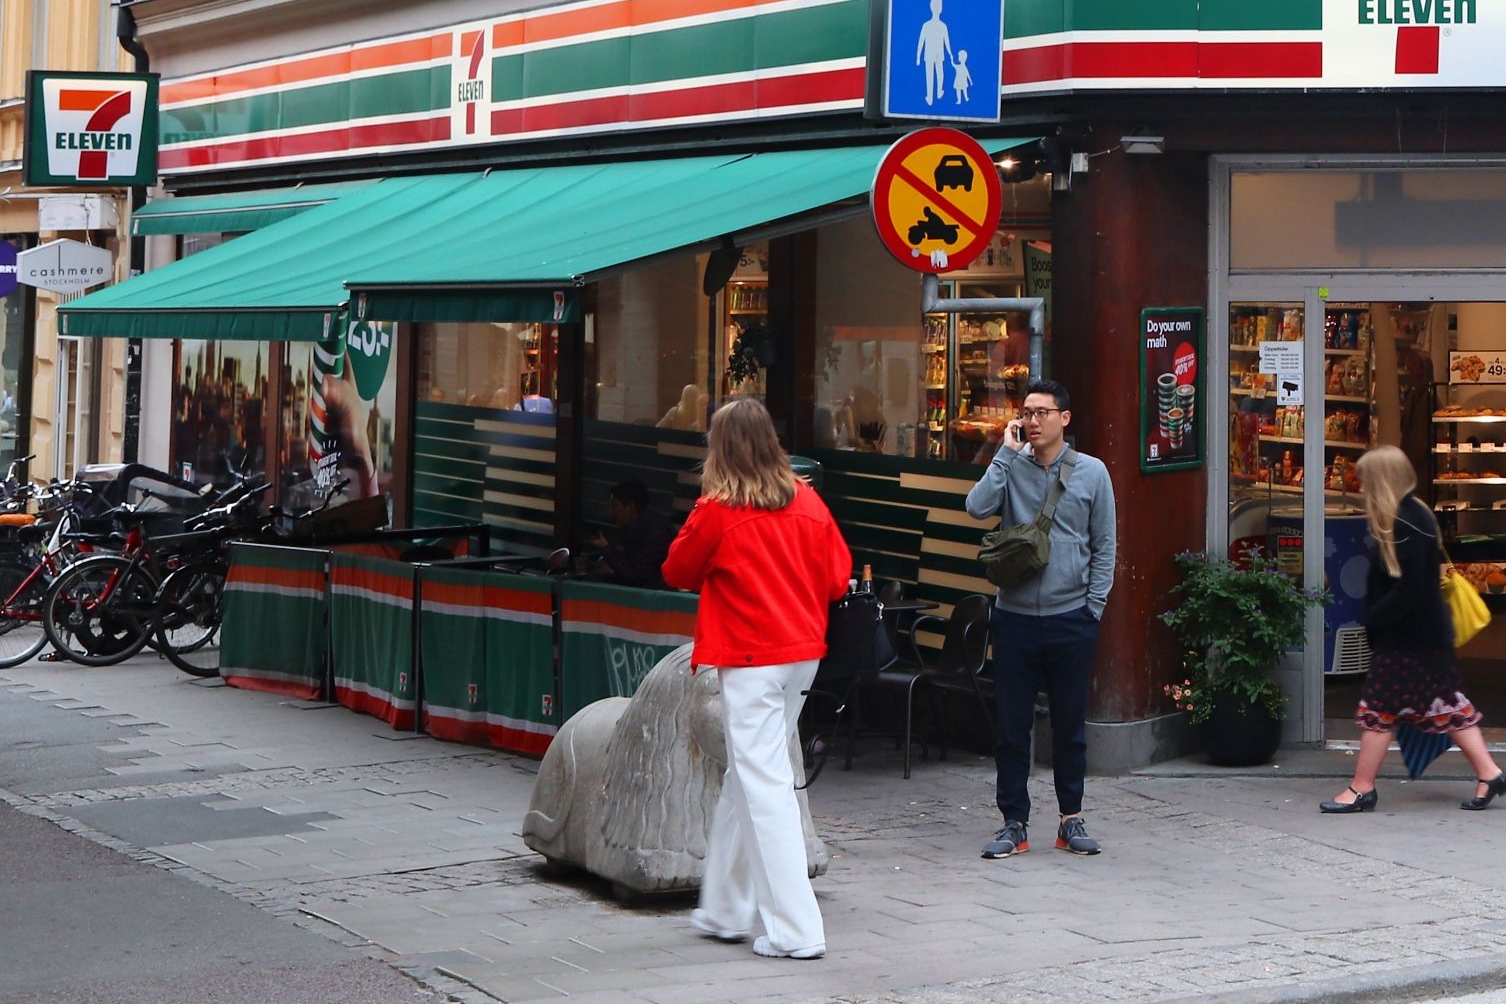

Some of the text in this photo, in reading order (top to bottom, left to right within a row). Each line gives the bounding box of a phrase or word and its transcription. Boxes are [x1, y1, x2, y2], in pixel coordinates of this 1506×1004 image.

[460, 28, 485, 135] 7
[59, 89, 131, 178] 7
[30, 244, 104, 277] cashmere
[1146, 335, 1167, 349] math
[1147, 320, 1191, 336] Do your own
